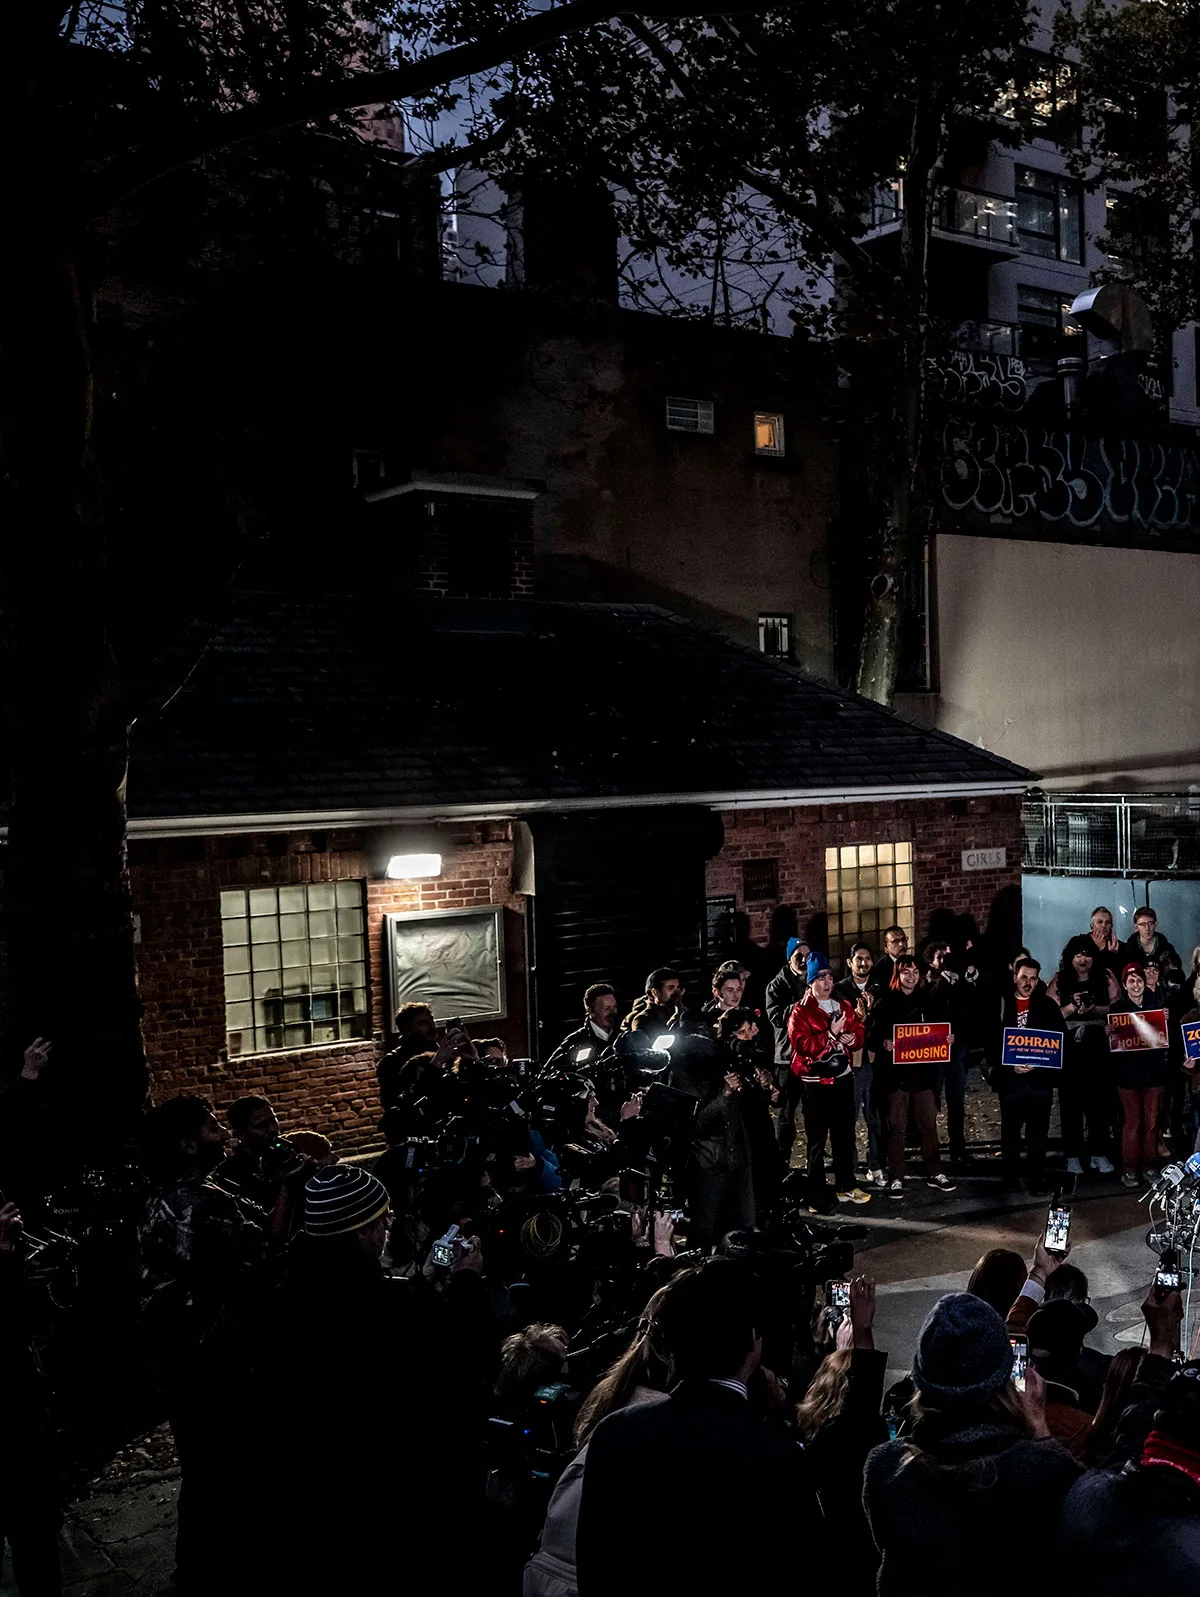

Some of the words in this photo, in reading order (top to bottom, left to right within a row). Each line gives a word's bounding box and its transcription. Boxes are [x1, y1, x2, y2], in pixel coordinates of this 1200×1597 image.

[966, 852, 1004, 868] GIRLS
[896, 1025, 931, 1039] BUILD
[1007, 1035, 1060, 1049] ZOHRAN
[900, 1044, 948, 1060] HOUSING
